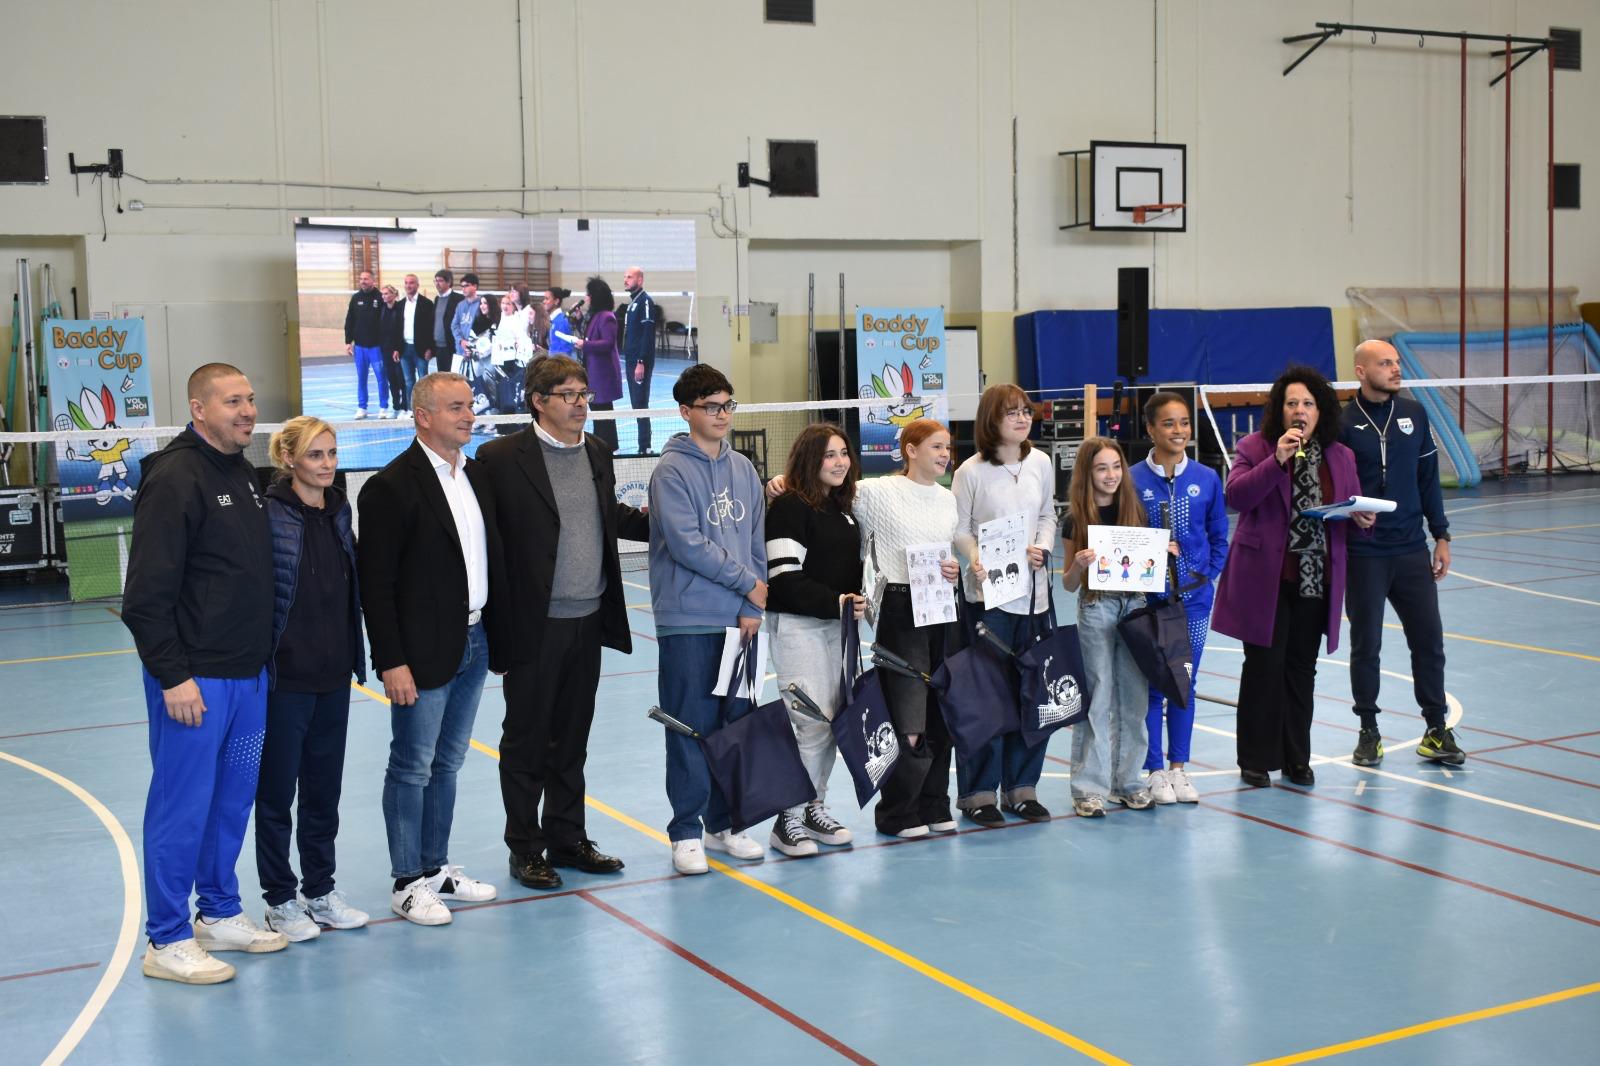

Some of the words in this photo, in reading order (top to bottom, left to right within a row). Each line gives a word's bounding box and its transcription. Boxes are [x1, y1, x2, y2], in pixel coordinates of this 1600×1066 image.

[863, 314, 929, 336] Baddy
[52, 326, 128, 352] Baddy
[901, 334, 940, 353] Cup
[98, 349, 142, 373] Cup
